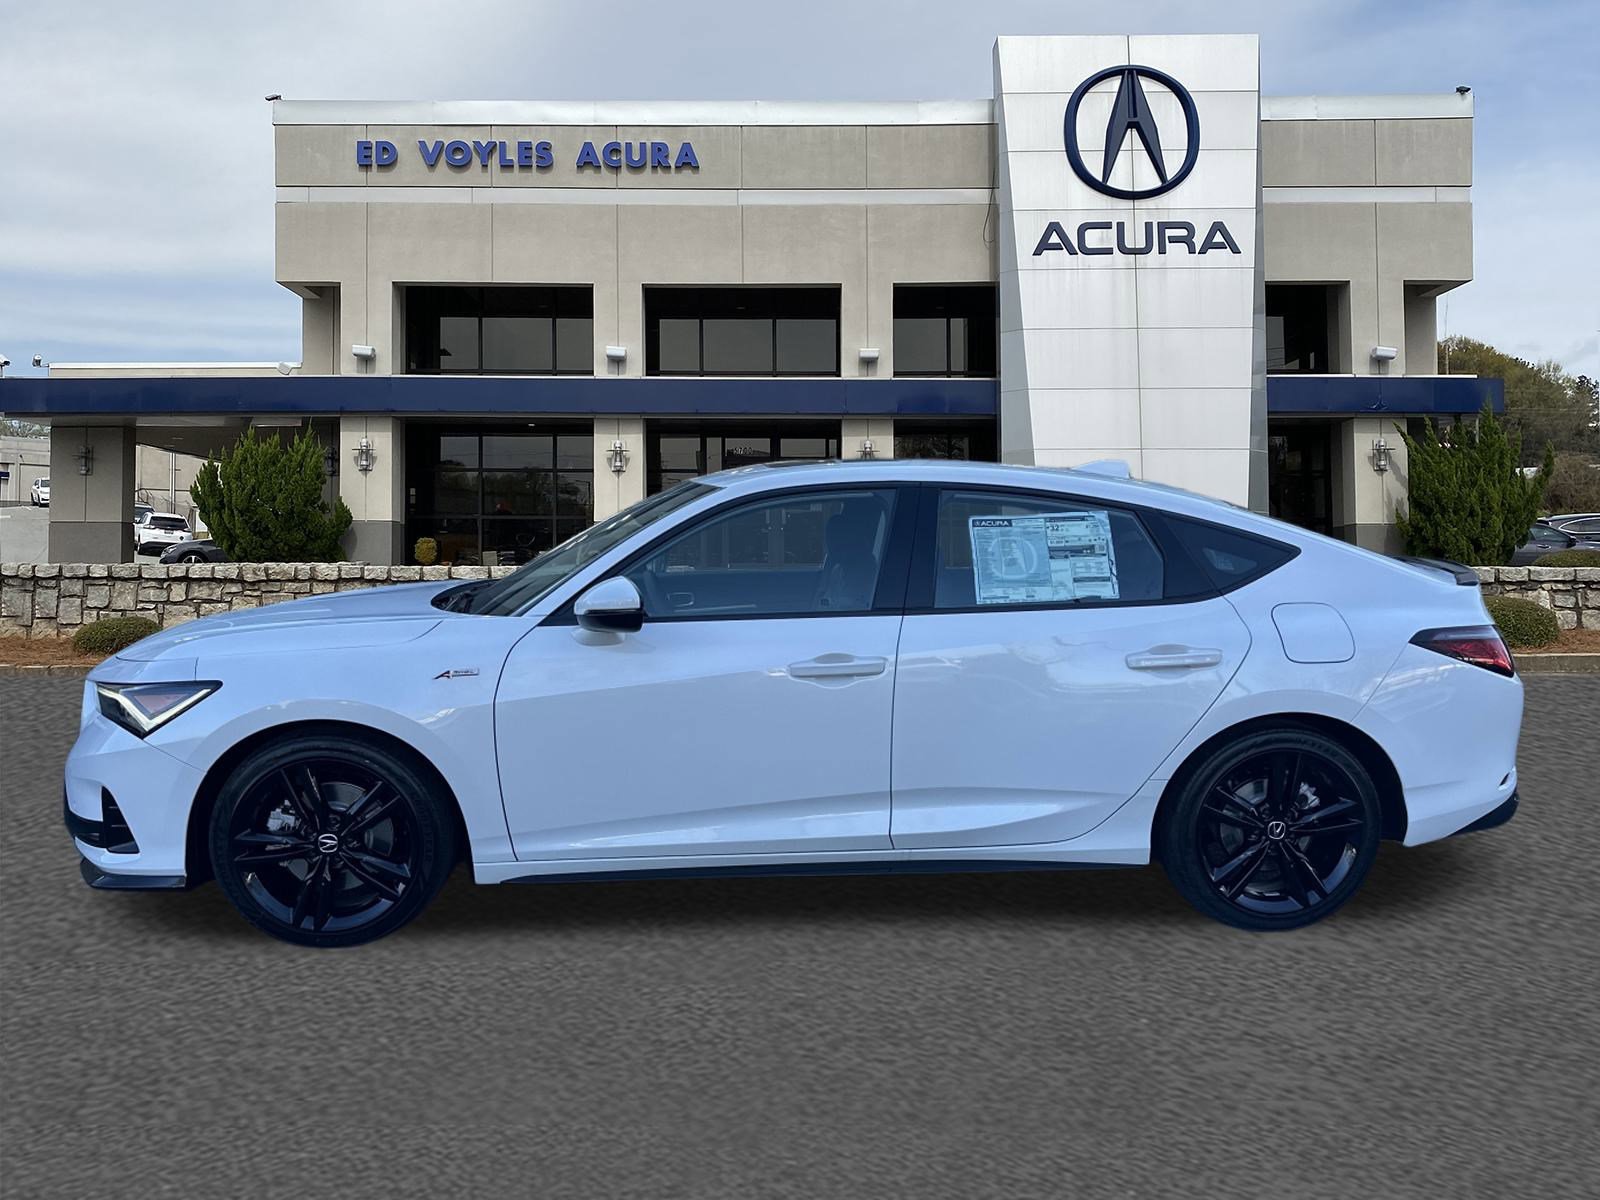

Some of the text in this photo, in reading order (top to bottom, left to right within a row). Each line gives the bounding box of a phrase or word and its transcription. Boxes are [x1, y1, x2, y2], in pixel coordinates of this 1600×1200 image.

[357, 140, 700, 169] ED VOYLES ACURA
[1032, 221, 1242, 256] ACURA
